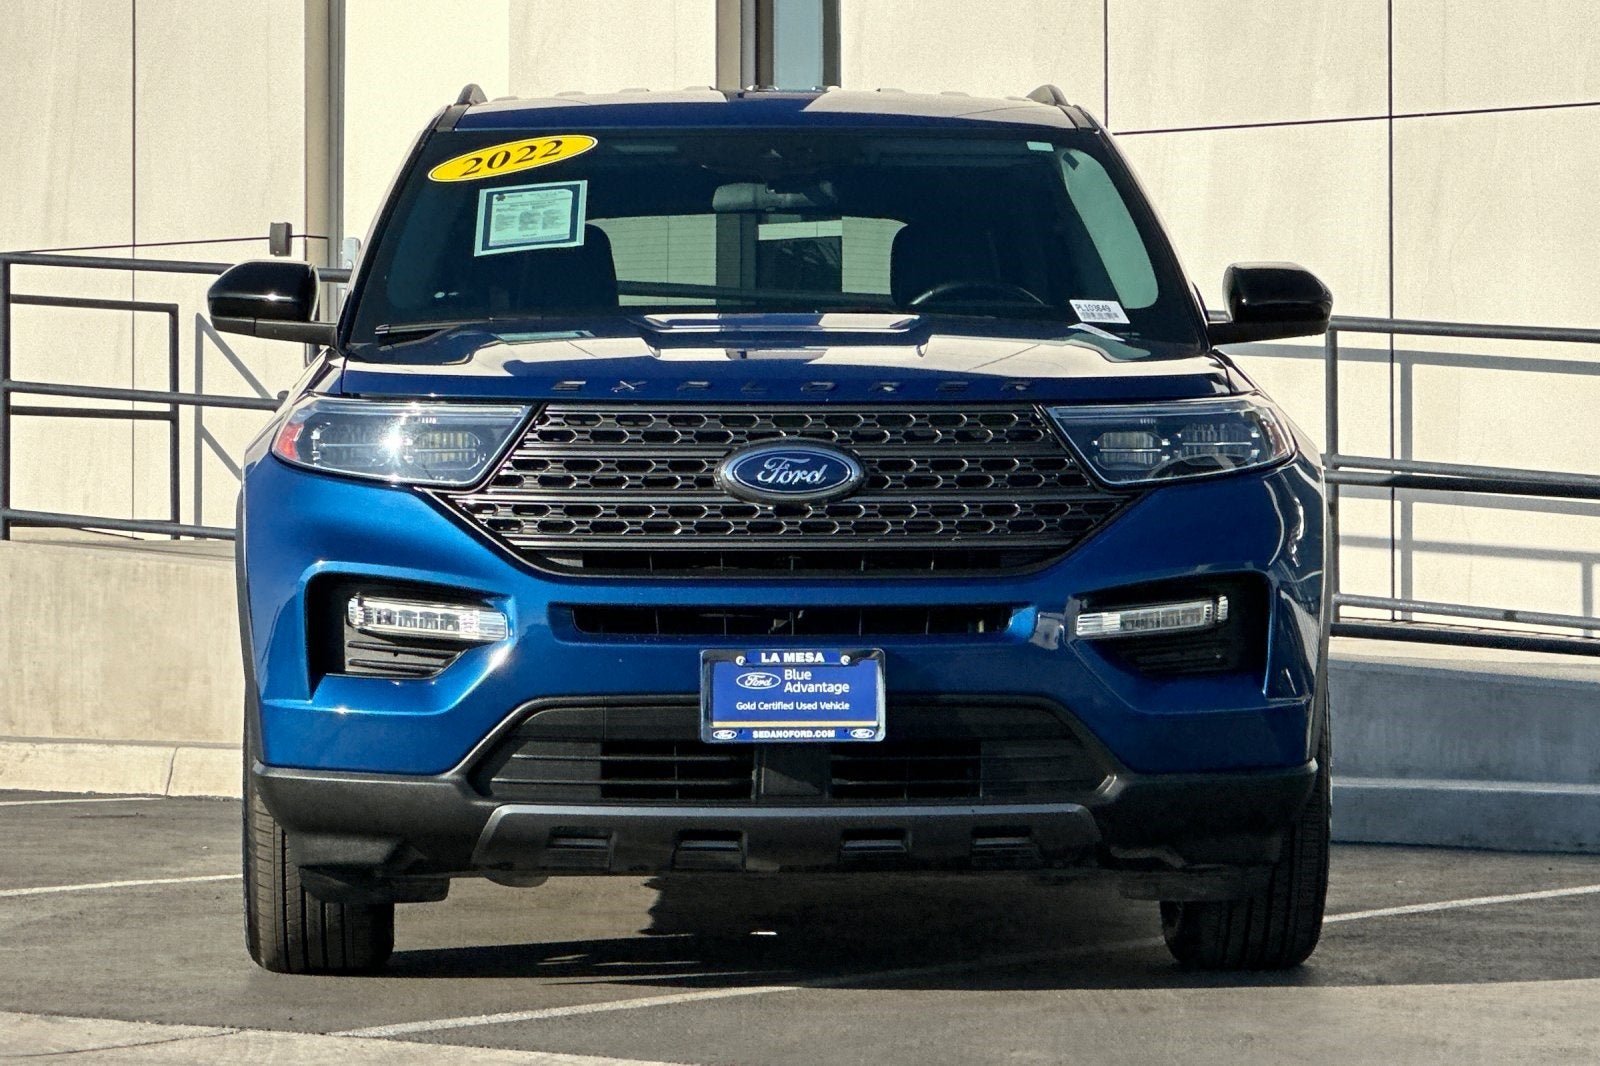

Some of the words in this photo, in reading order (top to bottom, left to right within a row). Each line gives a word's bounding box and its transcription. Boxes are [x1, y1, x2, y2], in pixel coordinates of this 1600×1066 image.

[460, 140, 563, 177] 2022
[757, 457, 828, 484] Ford
[761, 653, 780, 662] LA
[783, 653, 825, 662] MESA
[745, 674, 773, 687] Ford
[784, 669, 812, 680] Blue
[784, 682, 849, 695] Advantage
[736, 702, 756, 710] Gold
[758, 702, 794, 710] Certified
[796, 702, 817, 710] Used
[820, 702, 850, 710] Vehicle
[752, 730, 835, 738] SEDANOFORD.COM
